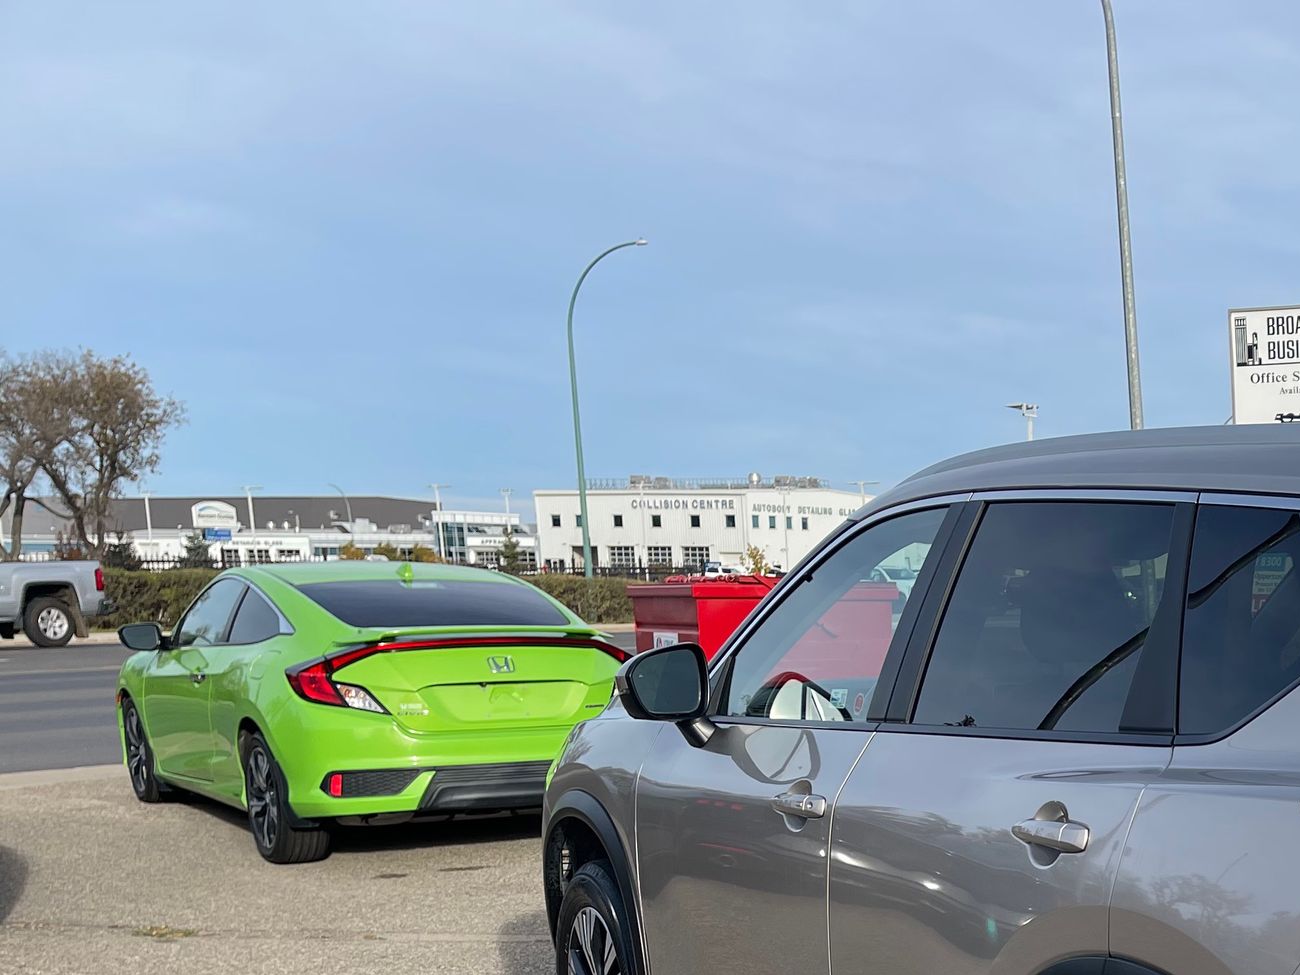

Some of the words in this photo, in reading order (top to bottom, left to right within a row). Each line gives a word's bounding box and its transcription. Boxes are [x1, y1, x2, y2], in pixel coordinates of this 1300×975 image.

[1250, 372, 1288, 384] Office
[631, 499, 688, 509] COLLISION
[691, 500, 734, 509] CENTRE
[798, 506, 833, 516] DETAILING
